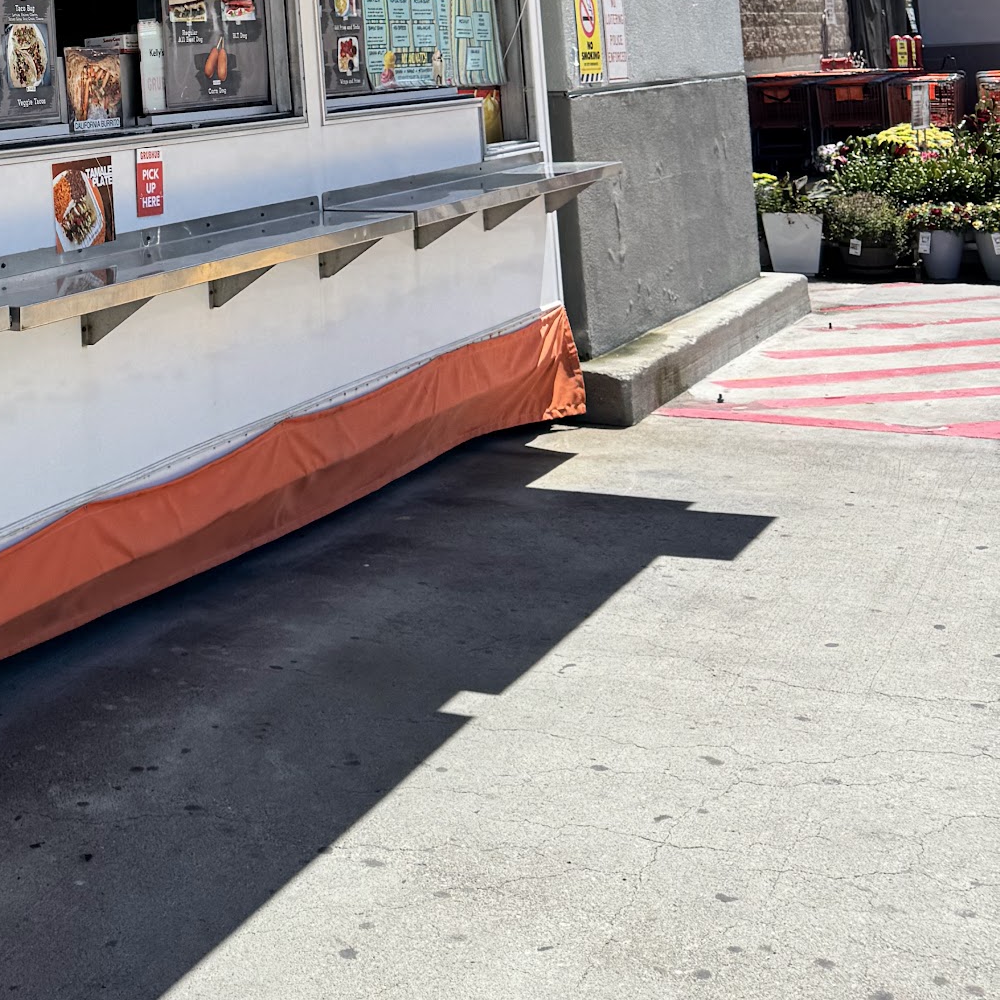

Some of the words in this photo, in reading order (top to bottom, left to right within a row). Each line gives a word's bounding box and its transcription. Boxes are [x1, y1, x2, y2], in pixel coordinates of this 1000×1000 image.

[149, 49, 165, 58] Kelly's
[581, 51, 600, 60] SMOKING
[75, 121, 100, 130] CALIFORNIA
[101, 119, 120, 128] BURRITO
[85, 165, 113, 179] TAMALE
[142, 168, 159, 180] PICK
[92, 175, 113, 187] PLATE
[145, 183, 156, 194] UP
[142, 197, 161, 208] HERE
